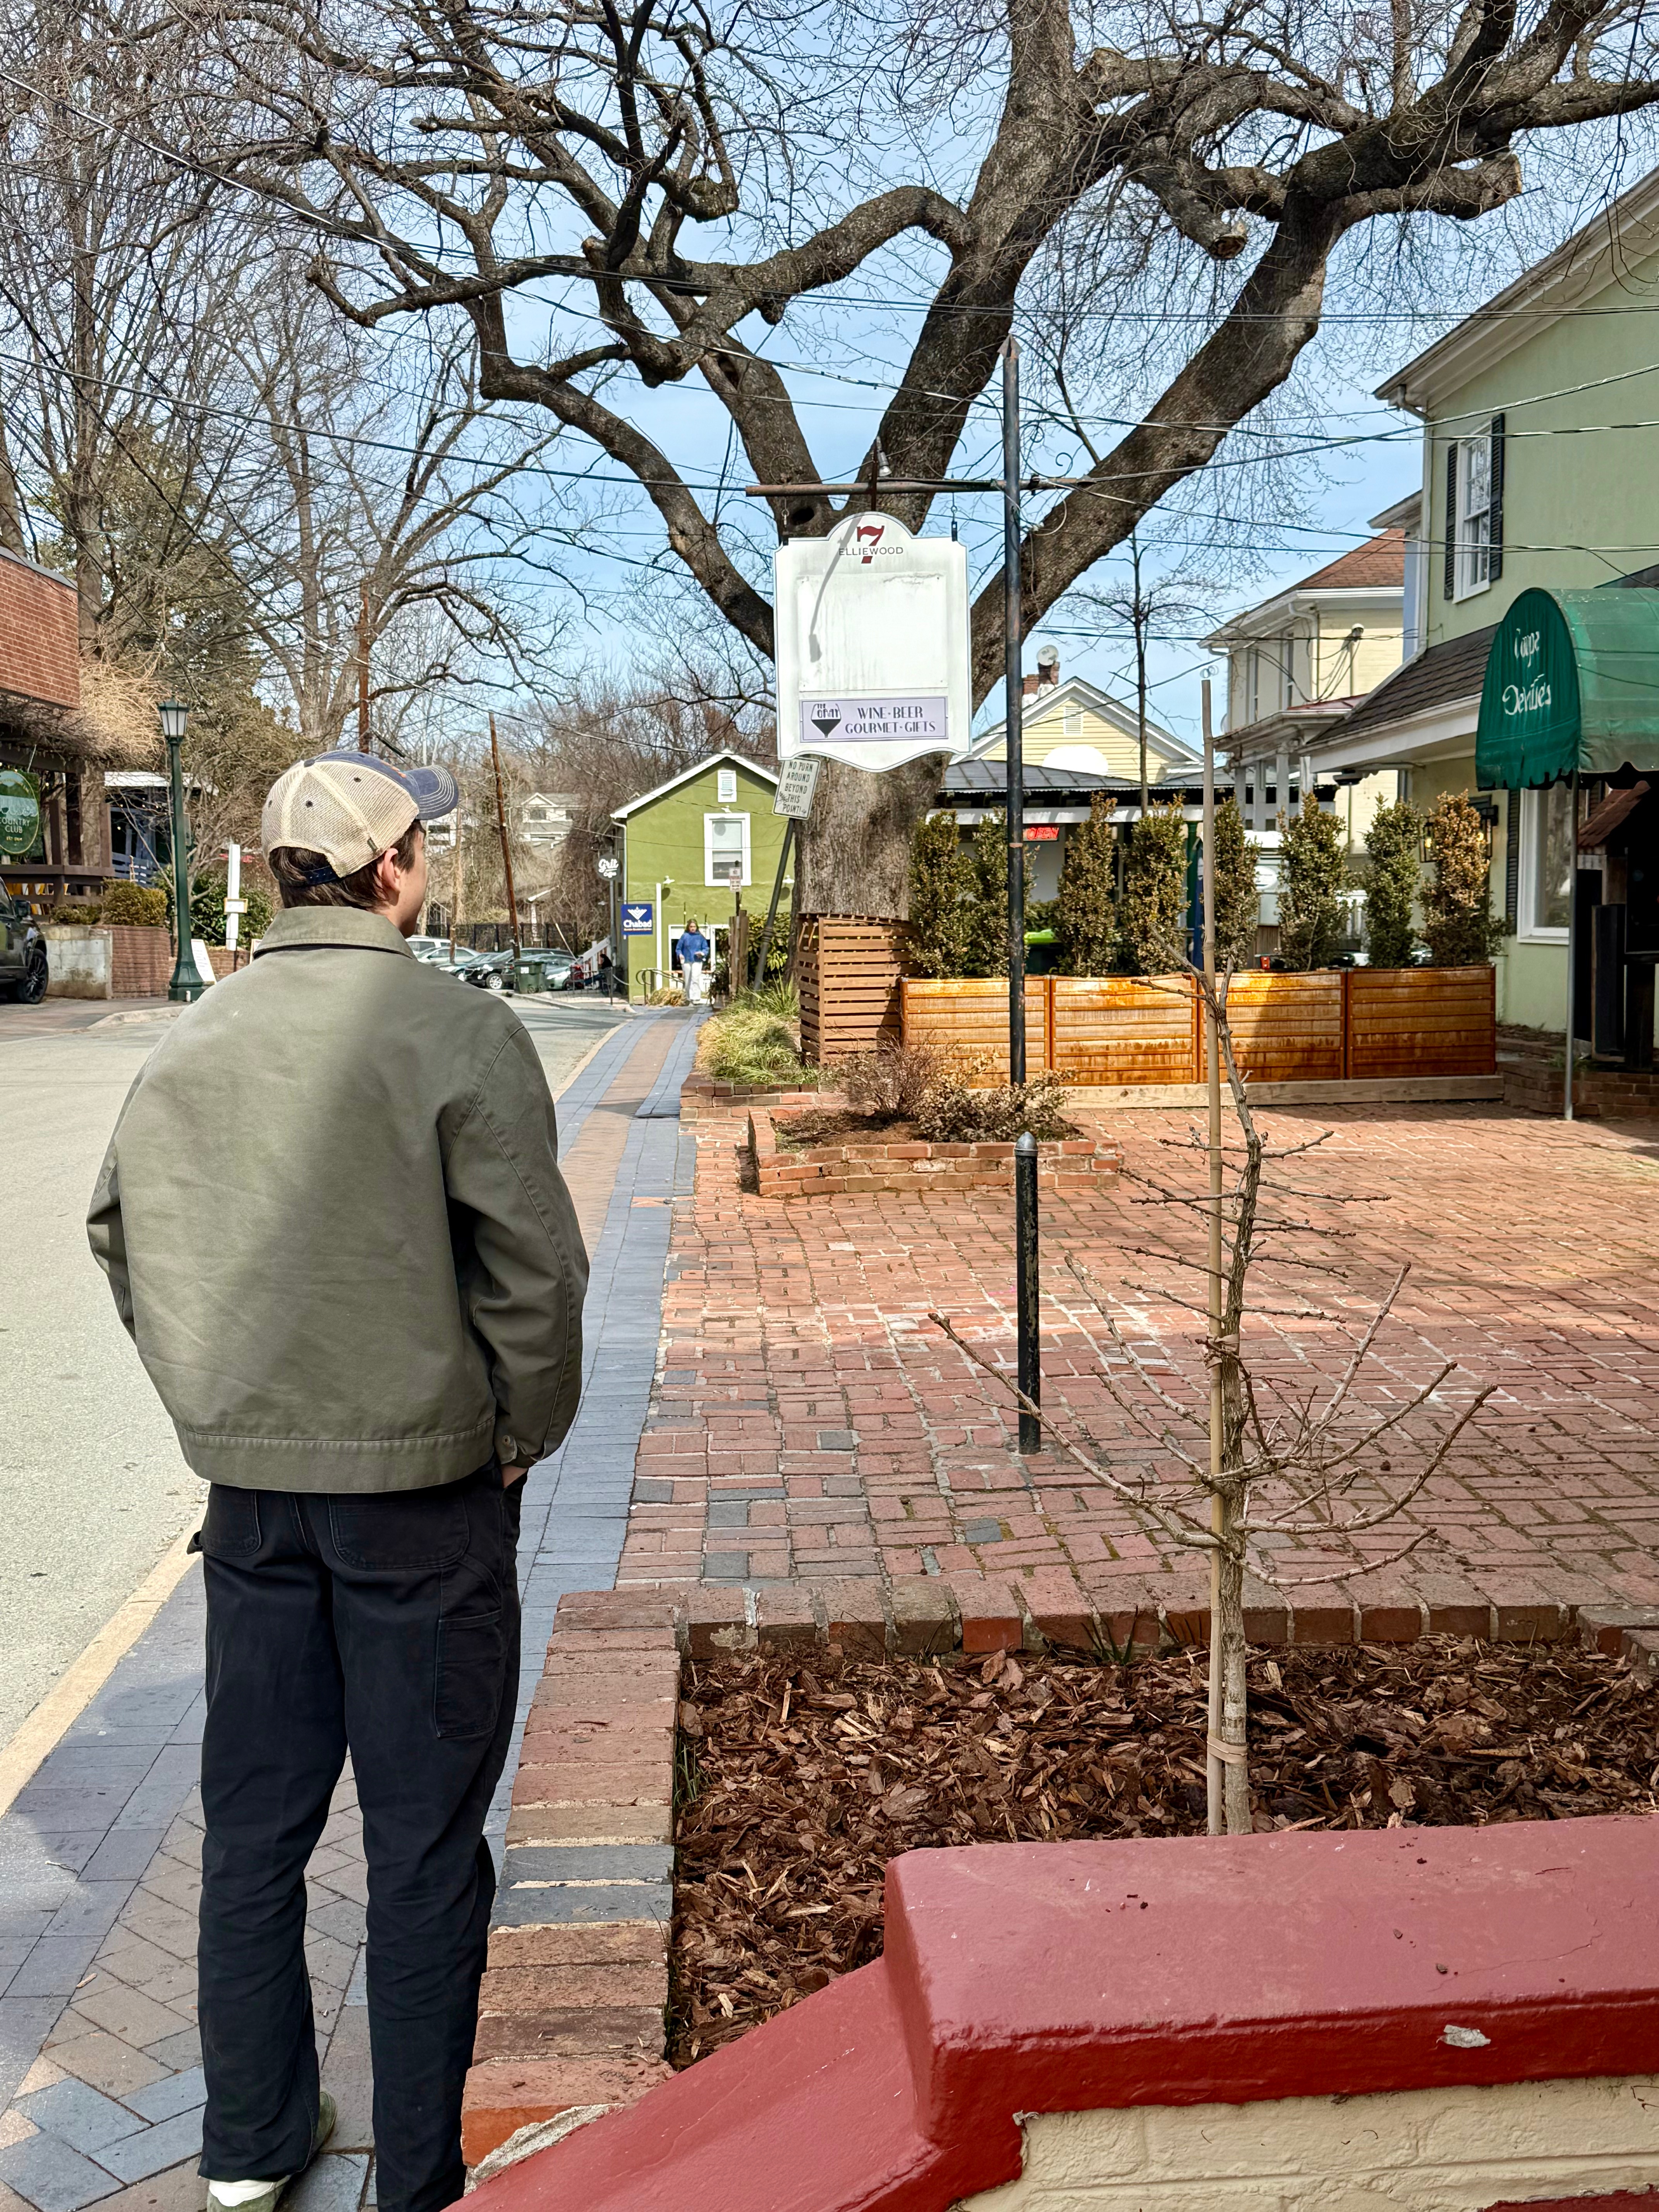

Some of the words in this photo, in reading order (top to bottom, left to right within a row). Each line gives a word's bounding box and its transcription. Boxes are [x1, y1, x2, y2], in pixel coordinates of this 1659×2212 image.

[857, 526, 884, 564] 7
[839, 547, 903, 555] ELLIEWOOD
[788, 761, 797, 769] NO
[799, 762, 814, 772] TURN
[787, 772, 810, 783] AROUND
[785, 783, 807, 794] BEYOND
[787, 794, 800, 804] THIS
[5, 825, 23, 833] CLUB
[1027, 827, 1059, 840] OPEN
[623, 919, 652, 927] Chabad
